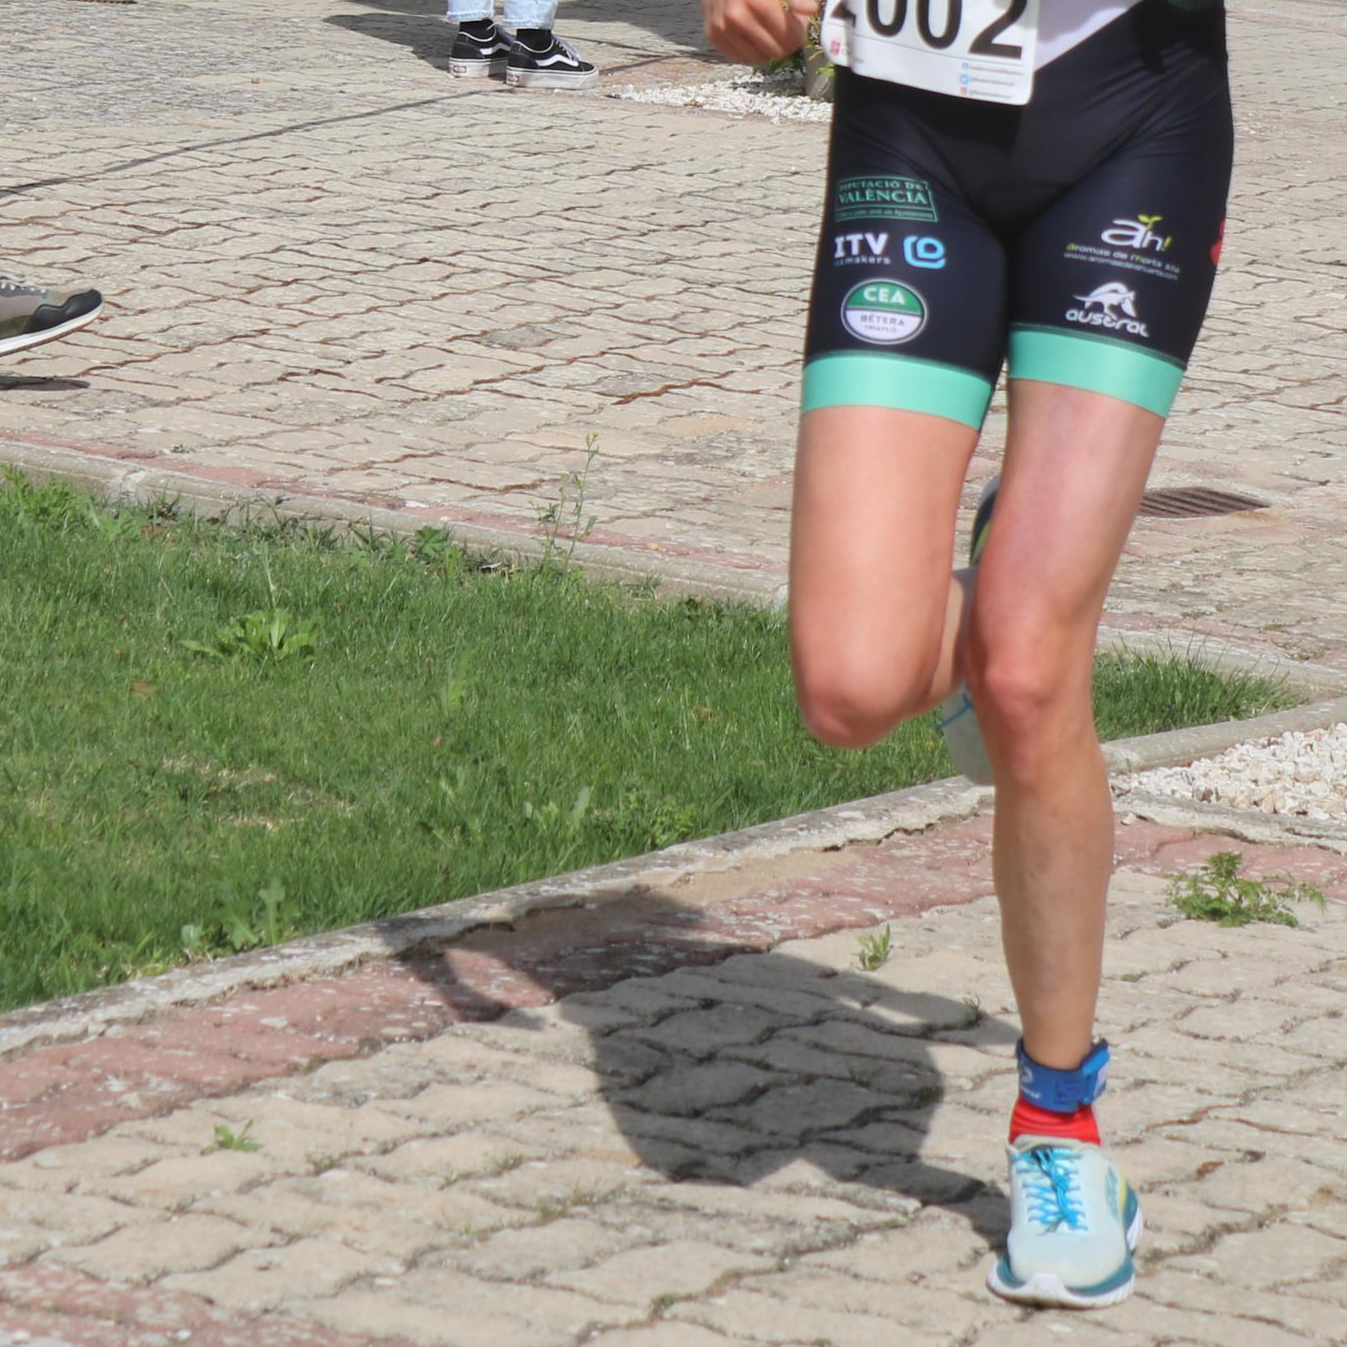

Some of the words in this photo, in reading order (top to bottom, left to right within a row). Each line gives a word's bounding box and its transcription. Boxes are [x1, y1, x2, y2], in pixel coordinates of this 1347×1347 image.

[905, 182, 925, 191] DE
[838, 189, 927, 204] VALÈNCIA
[834, 233, 888, 259] ITV
[863, 286, 905, 305] CEA
[1065, 309, 1149, 338] austral
